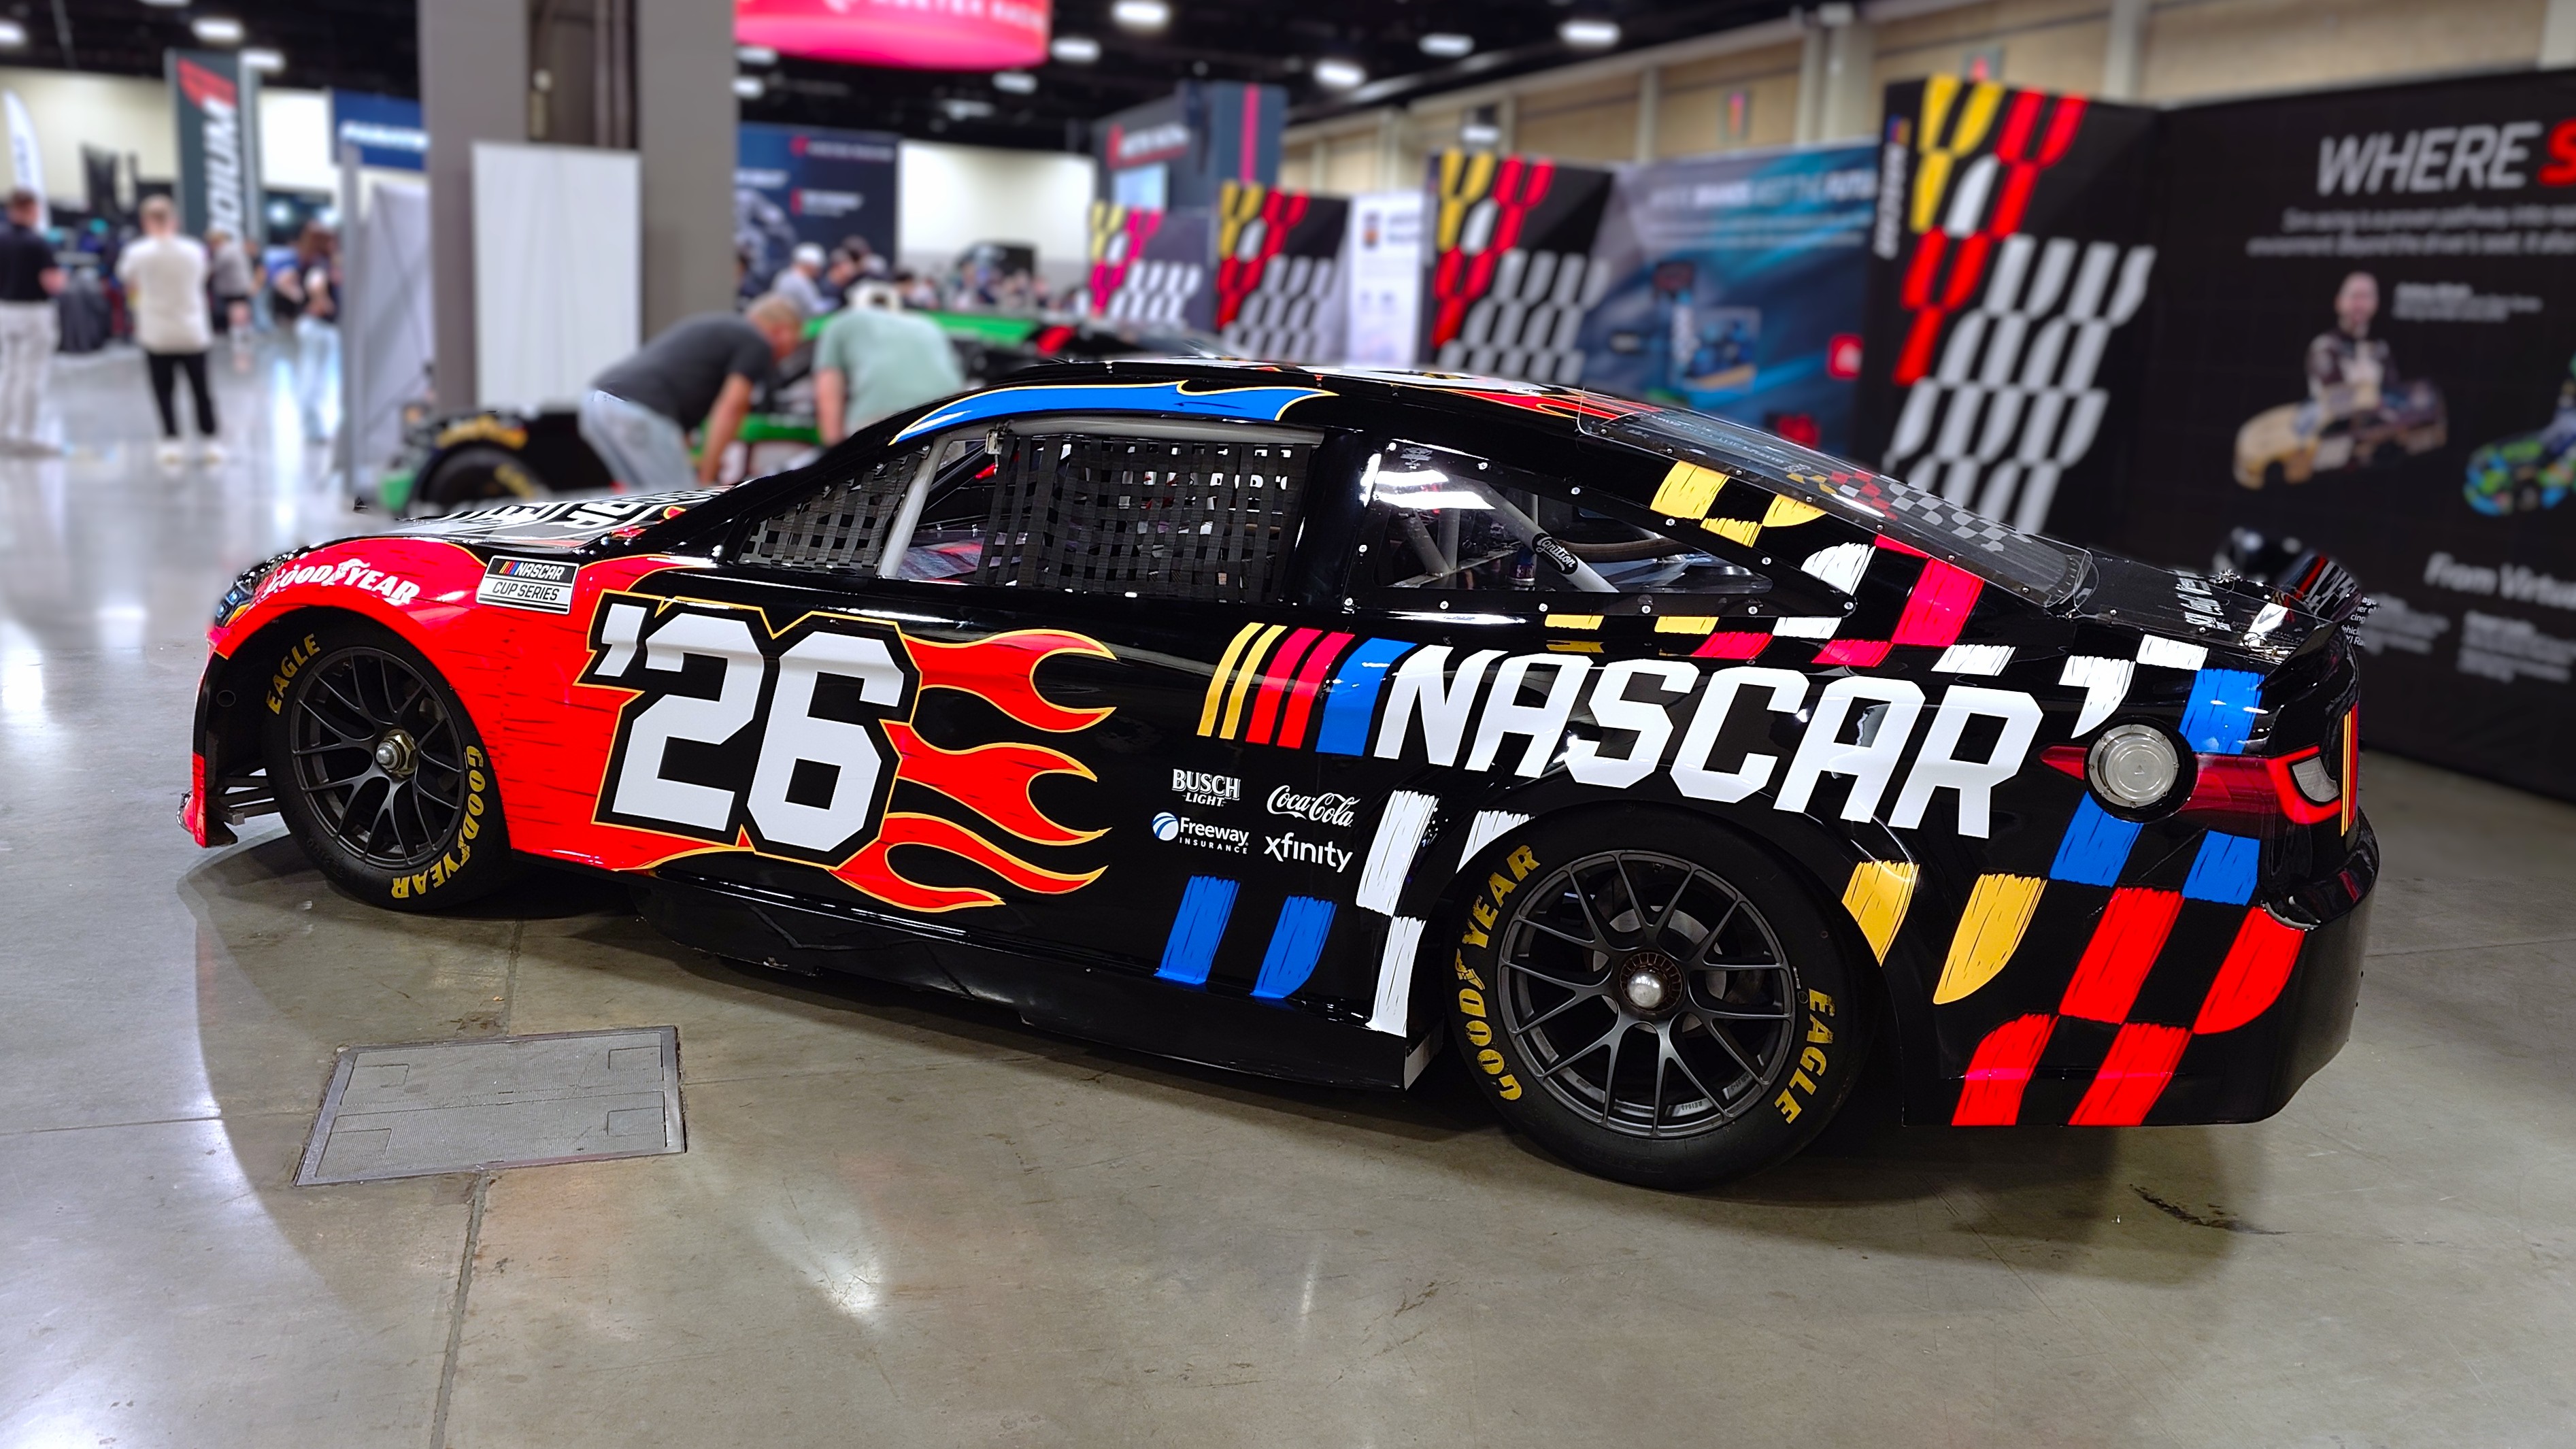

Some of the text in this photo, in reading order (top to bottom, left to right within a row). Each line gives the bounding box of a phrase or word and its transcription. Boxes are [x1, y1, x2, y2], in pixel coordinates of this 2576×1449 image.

[2317, 122, 2543, 195] WHERE
[261, 559, 420, 605] GOODYEAR
[492, 582, 559, 601] CUP SERIES
[514, 562, 565, 580] NASCAR
[266, 633, 321, 715] EAGLE
[1373, 644, 2043, 838] NASCAR
[1172, 769, 1240, 801] BUSCH
[1184, 792, 1225, 807] LIGHT
[1267, 784, 1360, 827] Coca-Cola
[391, 745, 486, 899] GOODYEAR
[1180, 817, 1249, 845] Freeway
[1180, 837, 1248, 854] INSURANCE
[1264, 833, 1352, 872] xfinity
[1455, 844, 1540, 1101] GOODYEAR
[1774, 988, 1837, 1124] EAGLE
